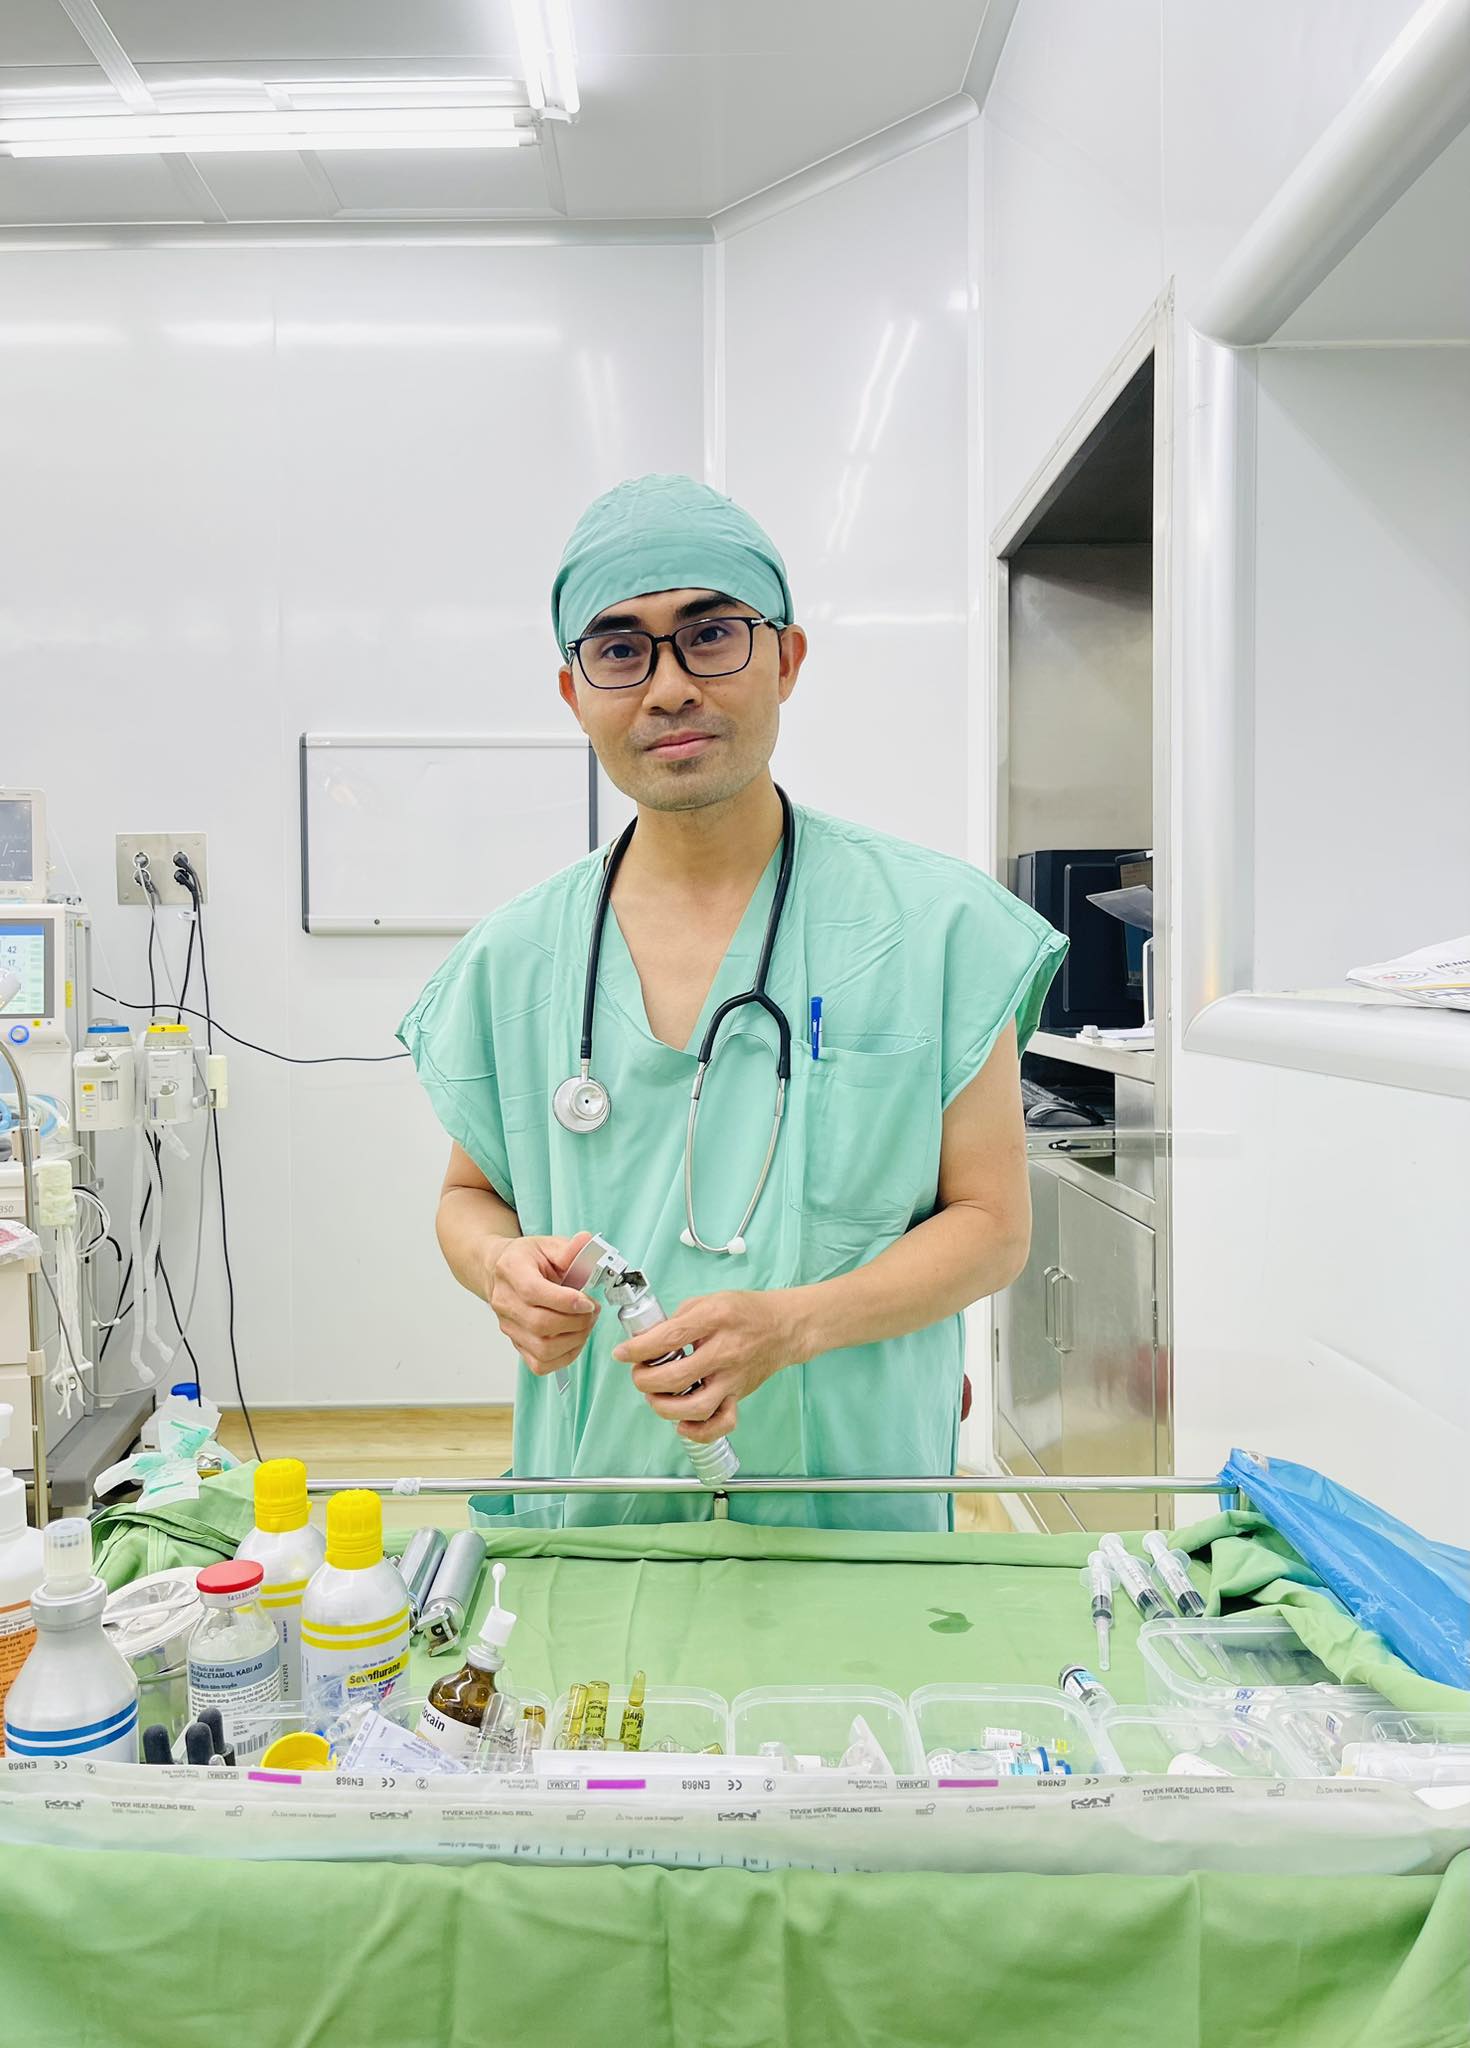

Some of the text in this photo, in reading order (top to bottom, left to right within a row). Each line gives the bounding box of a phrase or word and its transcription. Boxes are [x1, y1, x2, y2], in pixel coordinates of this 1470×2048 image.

[191, 1669, 235, 1679] PARACETAMOL
[236, 1667, 252, 1676] KABI
[682, 1780, 710, 1790] EN868
